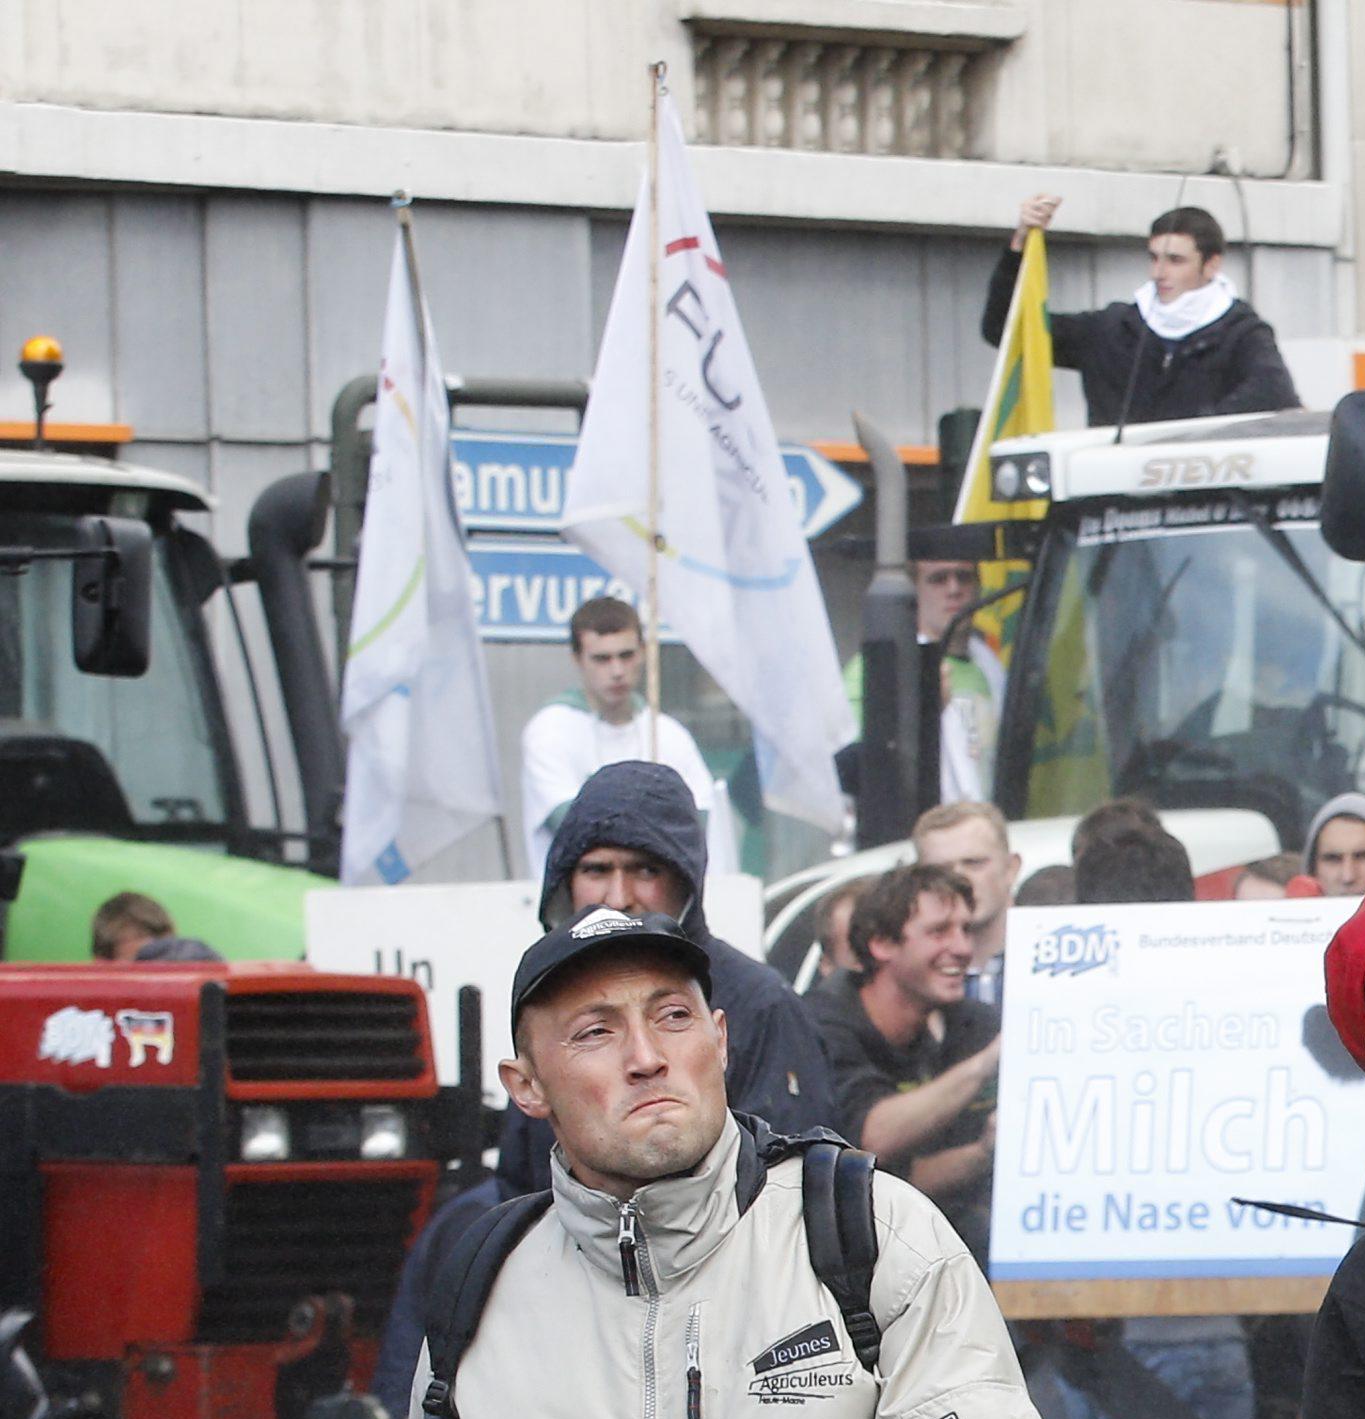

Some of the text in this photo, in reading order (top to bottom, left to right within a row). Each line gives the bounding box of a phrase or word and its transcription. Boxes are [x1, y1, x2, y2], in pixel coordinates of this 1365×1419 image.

[452, 461, 574, 514] amu
[1139, 454, 1255, 487] STEYR
[1034, 930, 1119, 966] BDM
[1137, 931, 1266, 949] Bundesverband
[1026, 1000, 1281, 1056] In Sachen
[1018, 1065, 1329, 1178] Milch
[1021, 1193, 1088, 1235] die
[1103, 1192, 1210, 1233] Nase
[769, 1335, 831, 1368] Jeunes
[759, 1372, 854, 1395] Agriculteurs
